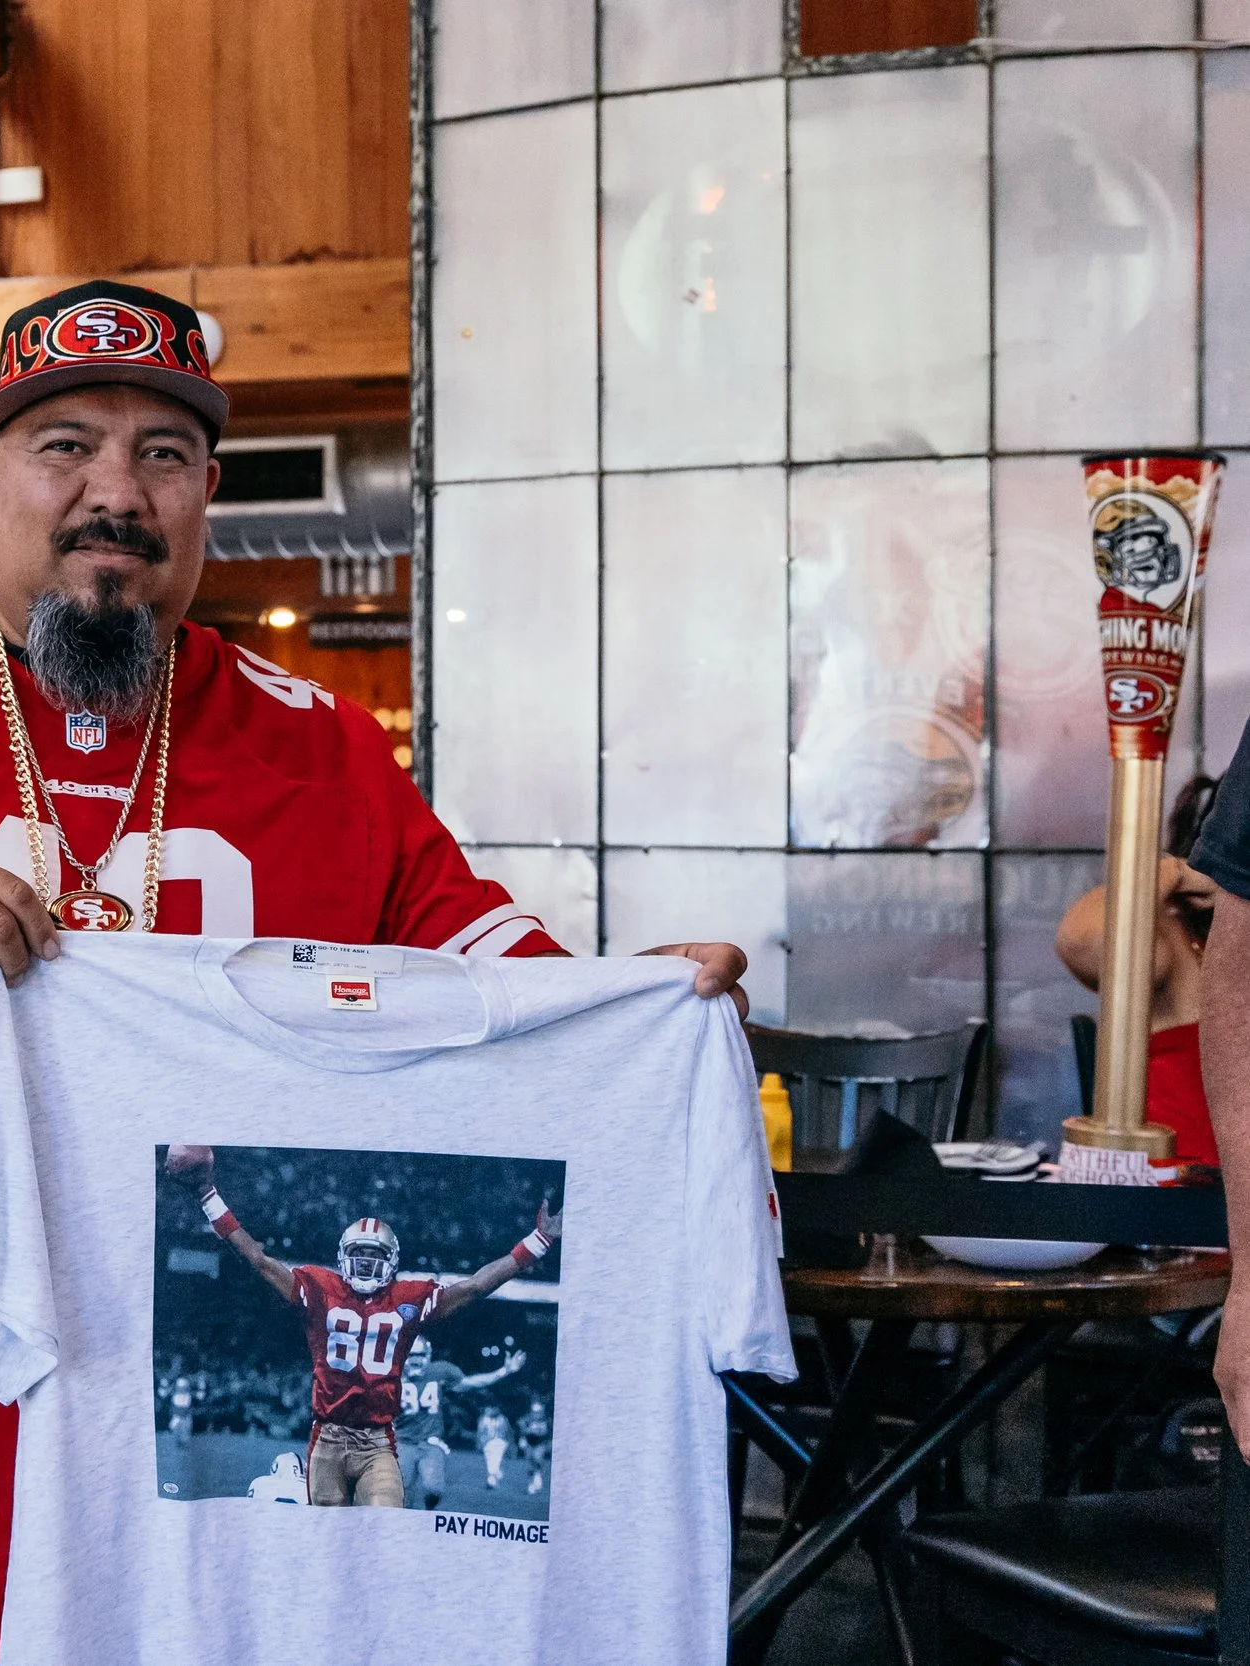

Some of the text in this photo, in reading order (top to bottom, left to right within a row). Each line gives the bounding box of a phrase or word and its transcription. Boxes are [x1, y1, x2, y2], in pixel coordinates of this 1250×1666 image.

[73, 728, 101, 745] NFL
[44, 779, 132, 802] 49ERS
[326, 1306, 403, 1376] 80
[435, 1515, 550, 1544] PAY HOMAGE
